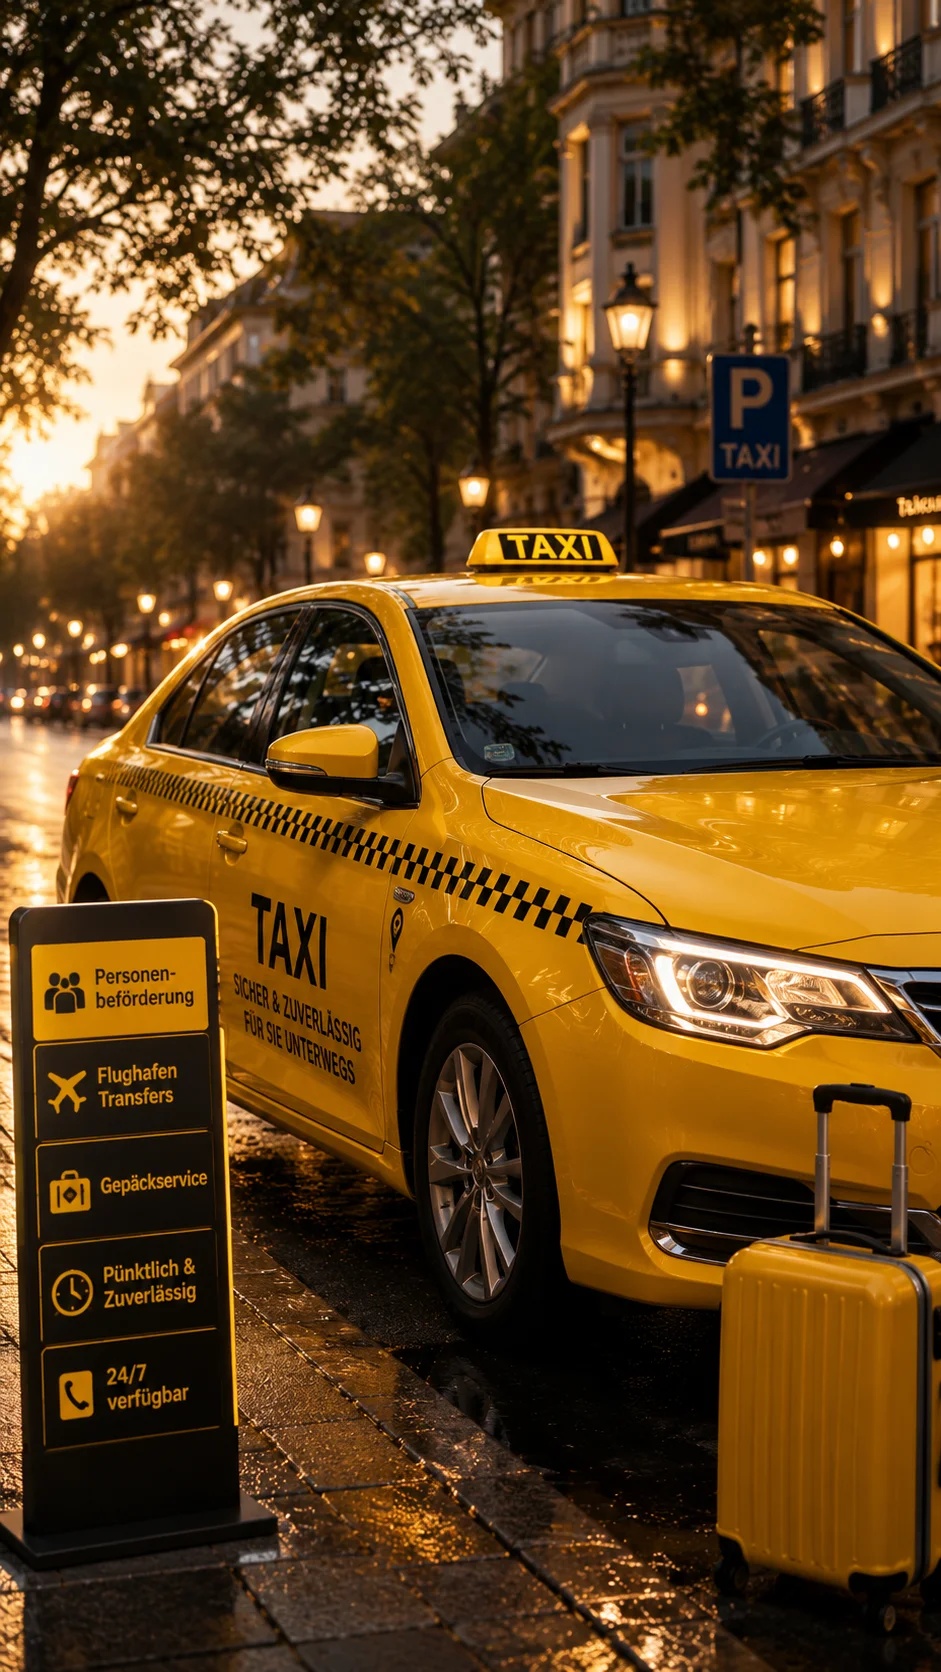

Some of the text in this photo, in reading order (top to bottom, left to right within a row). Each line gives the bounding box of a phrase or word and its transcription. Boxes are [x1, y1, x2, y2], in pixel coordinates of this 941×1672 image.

[730, 367, 773, 430] P
[719, 442, 781, 470] TAXI
[506, 534, 594, 559] TAXI
[251, 892, 327, 990] TAXI
[95, 967, 176, 985] Personen-
[96, 989, 194, 1009] beförderung
[233, 972, 270, 1010] SICHER
[272, 990, 281, 1014] &
[243, 1009, 356, 1085] FÜR SIE UNTERWEGS
[97, 1062, 178, 1087] Flughafen
[98, 1087, 174, 1108] Transfers
[100, 1170, 208, 1197] Gepäckservice
[103, 1257, 196, 1284] Pünktlich &
[104, 1281, 197, 1309] Zuverlässig
[106, 1363, 147, 1386] 24/7
[107, 1385, 189, 1411] verfügbar
